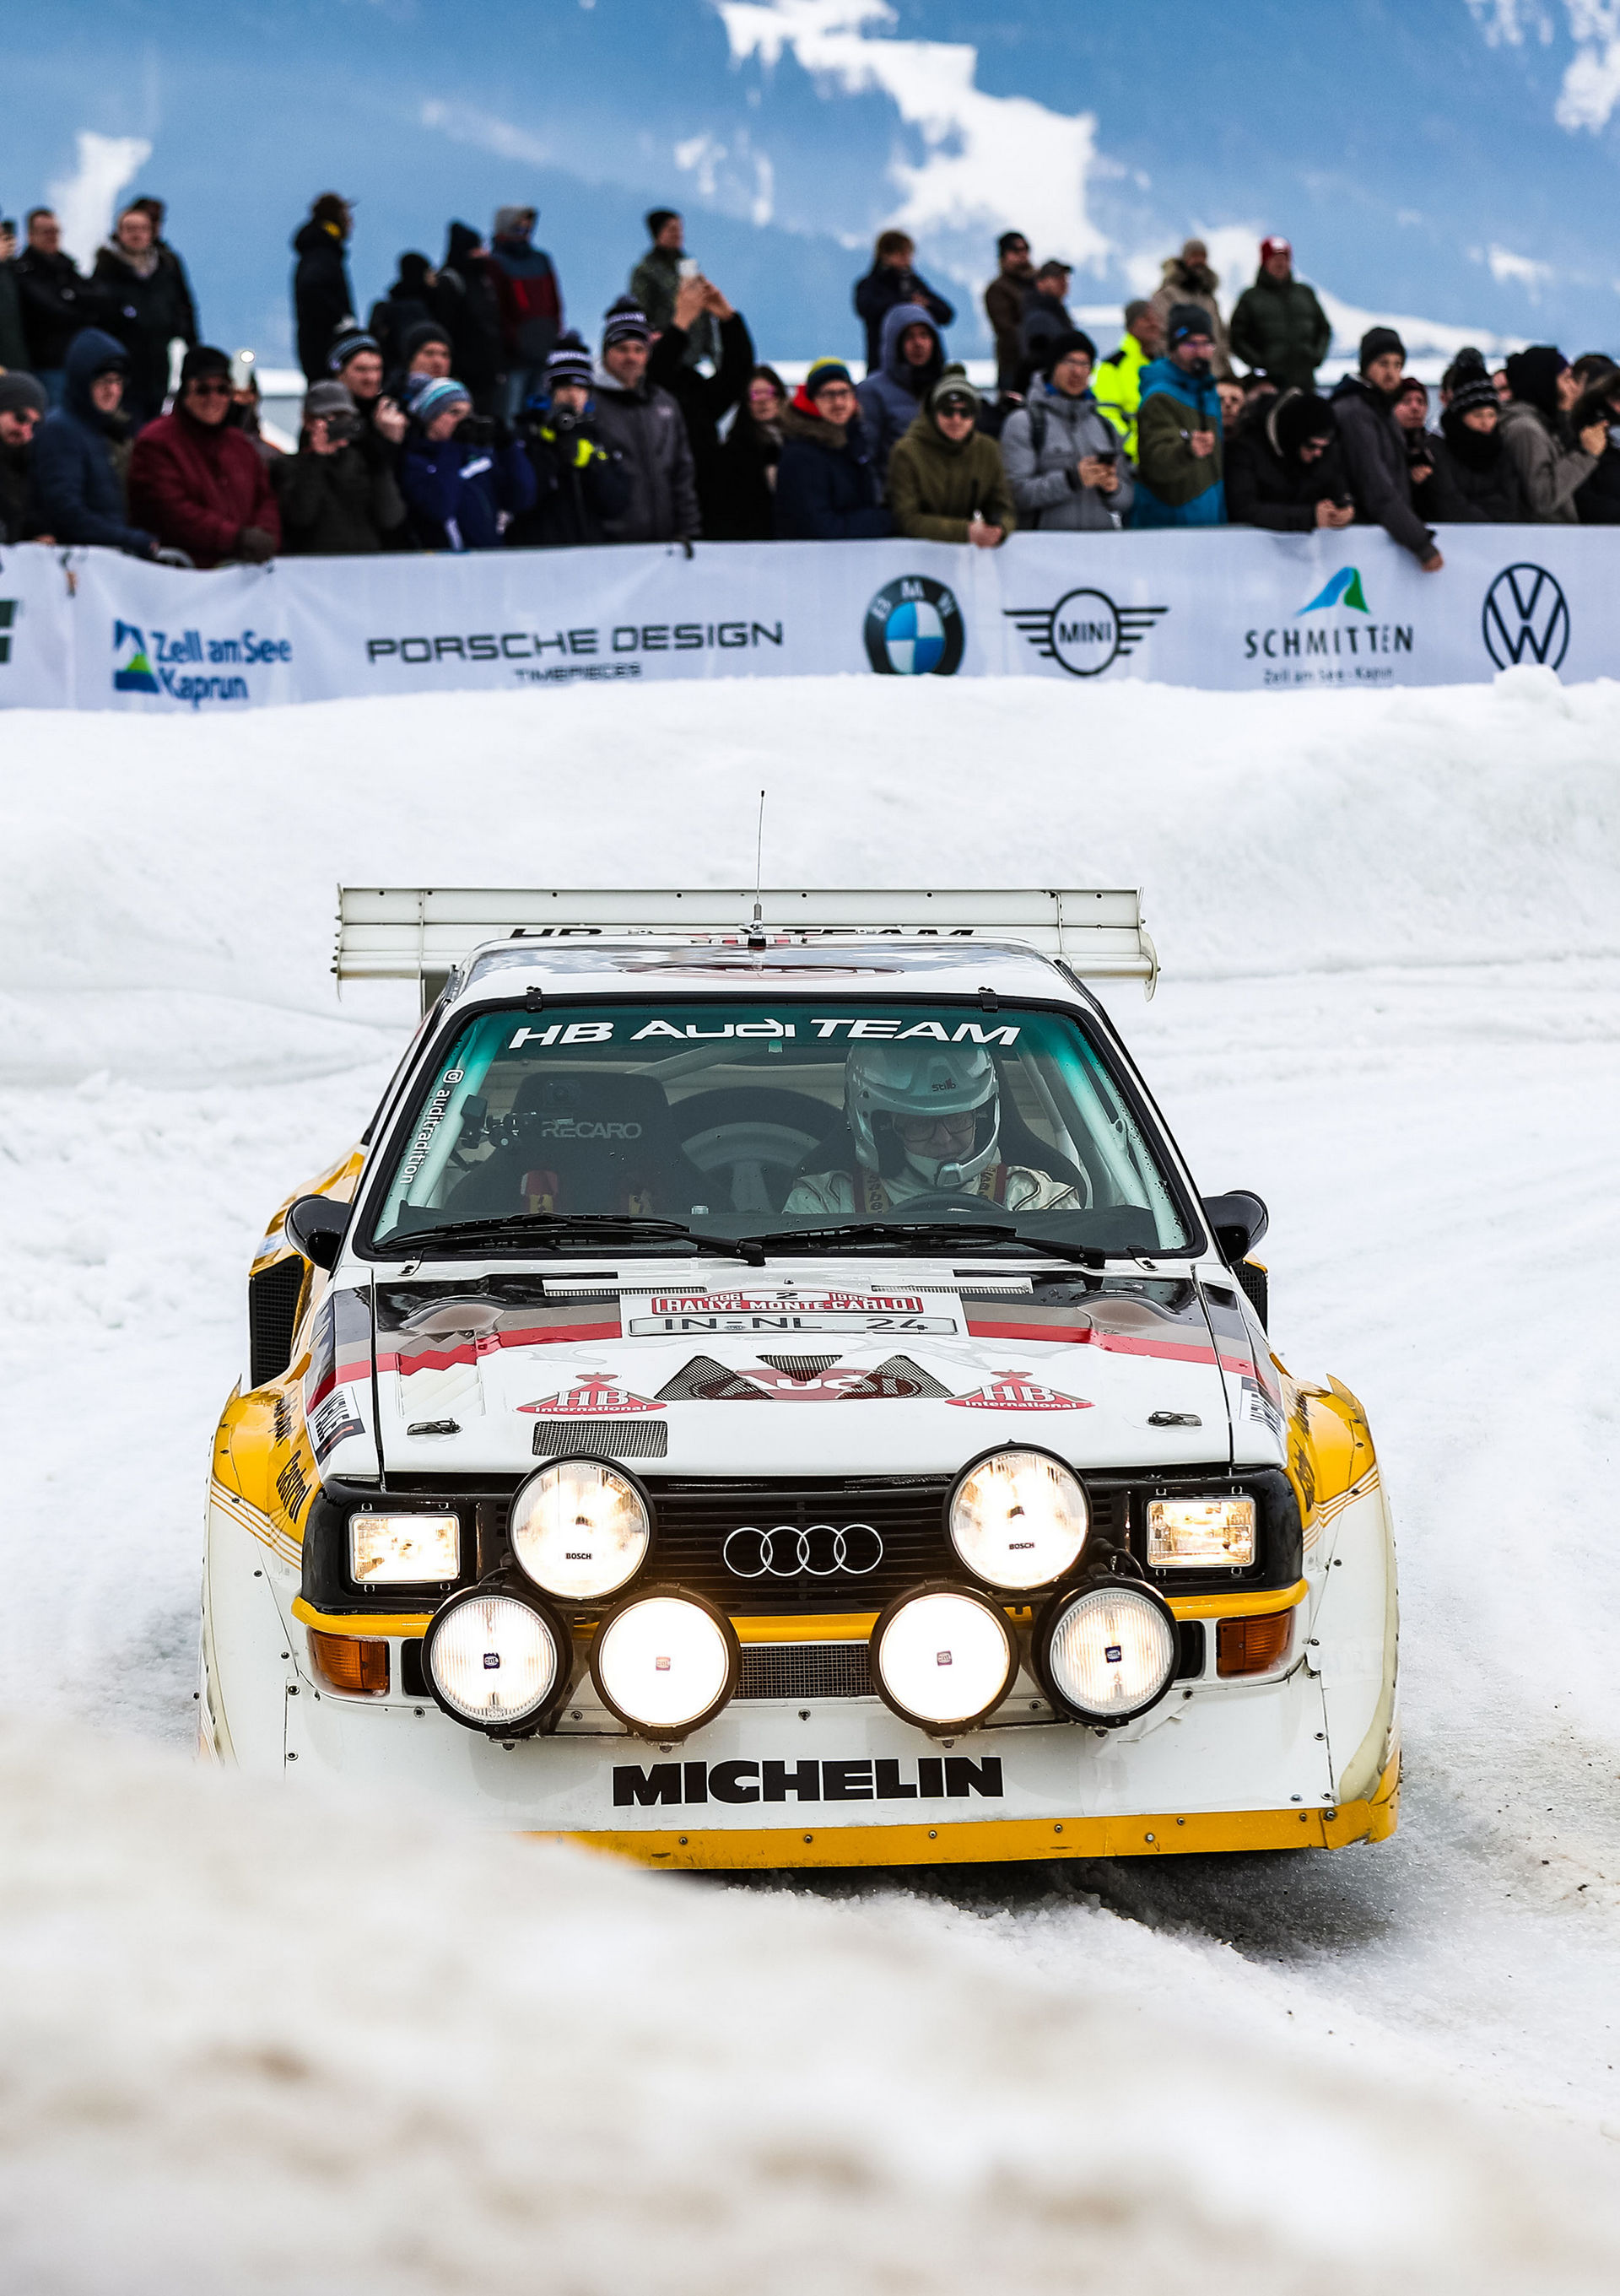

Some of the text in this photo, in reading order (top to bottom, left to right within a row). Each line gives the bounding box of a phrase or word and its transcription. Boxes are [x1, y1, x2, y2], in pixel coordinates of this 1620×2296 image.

[366, 621, 784, 665] PORSCHE DESIGN
[1057, 621, 1112, 644] MINI
[1245, 625, 1413, 659] SCHMITTEN
[150, 629, 293, 664] Zell am See
[158, 666, 249, 710] Kaprun
[508, 1018, 1023, 1050] HB Audi TEAM
[399, 1089, 451, 1185] auditradition
[541, 1121, 642, 1140] RECARO
[667, 1298, 907, 1311] RALLYE MONTE-CARLO
[776, 1292, 798, 1300] 2
[866, 1317, 929, 1331] 24
[556, 1390, 630, 1407] HB
[980, 1386, 1057, 1403] HB
[565, 1552, 592, 1560] BOSCH
[1008, 1542, 1035, 1550] BOSCH
[612, 1756, 1004, 1807] MICHELIN
